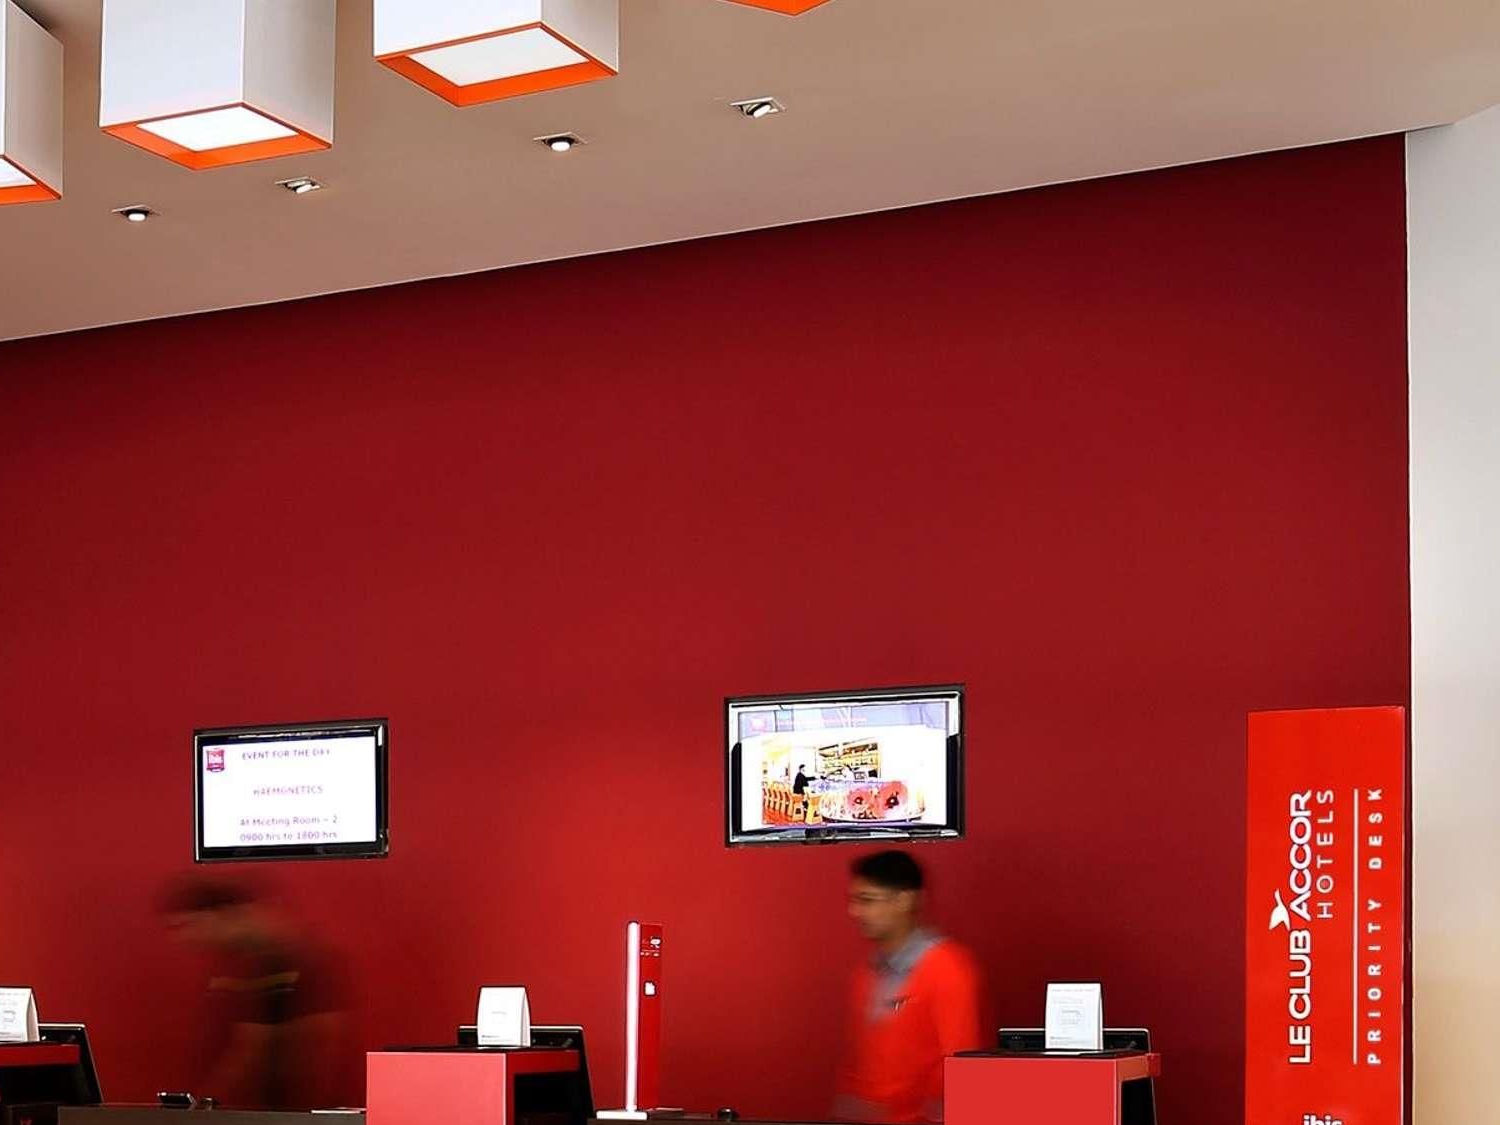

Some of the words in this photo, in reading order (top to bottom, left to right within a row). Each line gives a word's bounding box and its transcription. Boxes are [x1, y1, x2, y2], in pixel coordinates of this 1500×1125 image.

[242, 751, 269, 761] EVENT
[272, 750, 290, 759] FOR
[293, 749, 310, 758] THE
[252, 817, 291, 828] Meeting
[292, 815, 321, 825] Room
[265, 832, 282, 842] hrs
[283, 832, 293, 841] to
[321, 830, 338, 839] hrs
[1289, 790, 1313, 922] ACCOR
[1316, 789, 1335, 919] HOTELS
[1366, 788, 1383, 870] DESK
[1289, 929, 1312, 1020] CLUB
[1366, 898, 1383, 1065] PRIORITY
[1289, 1025, 1312, 1065] LE
